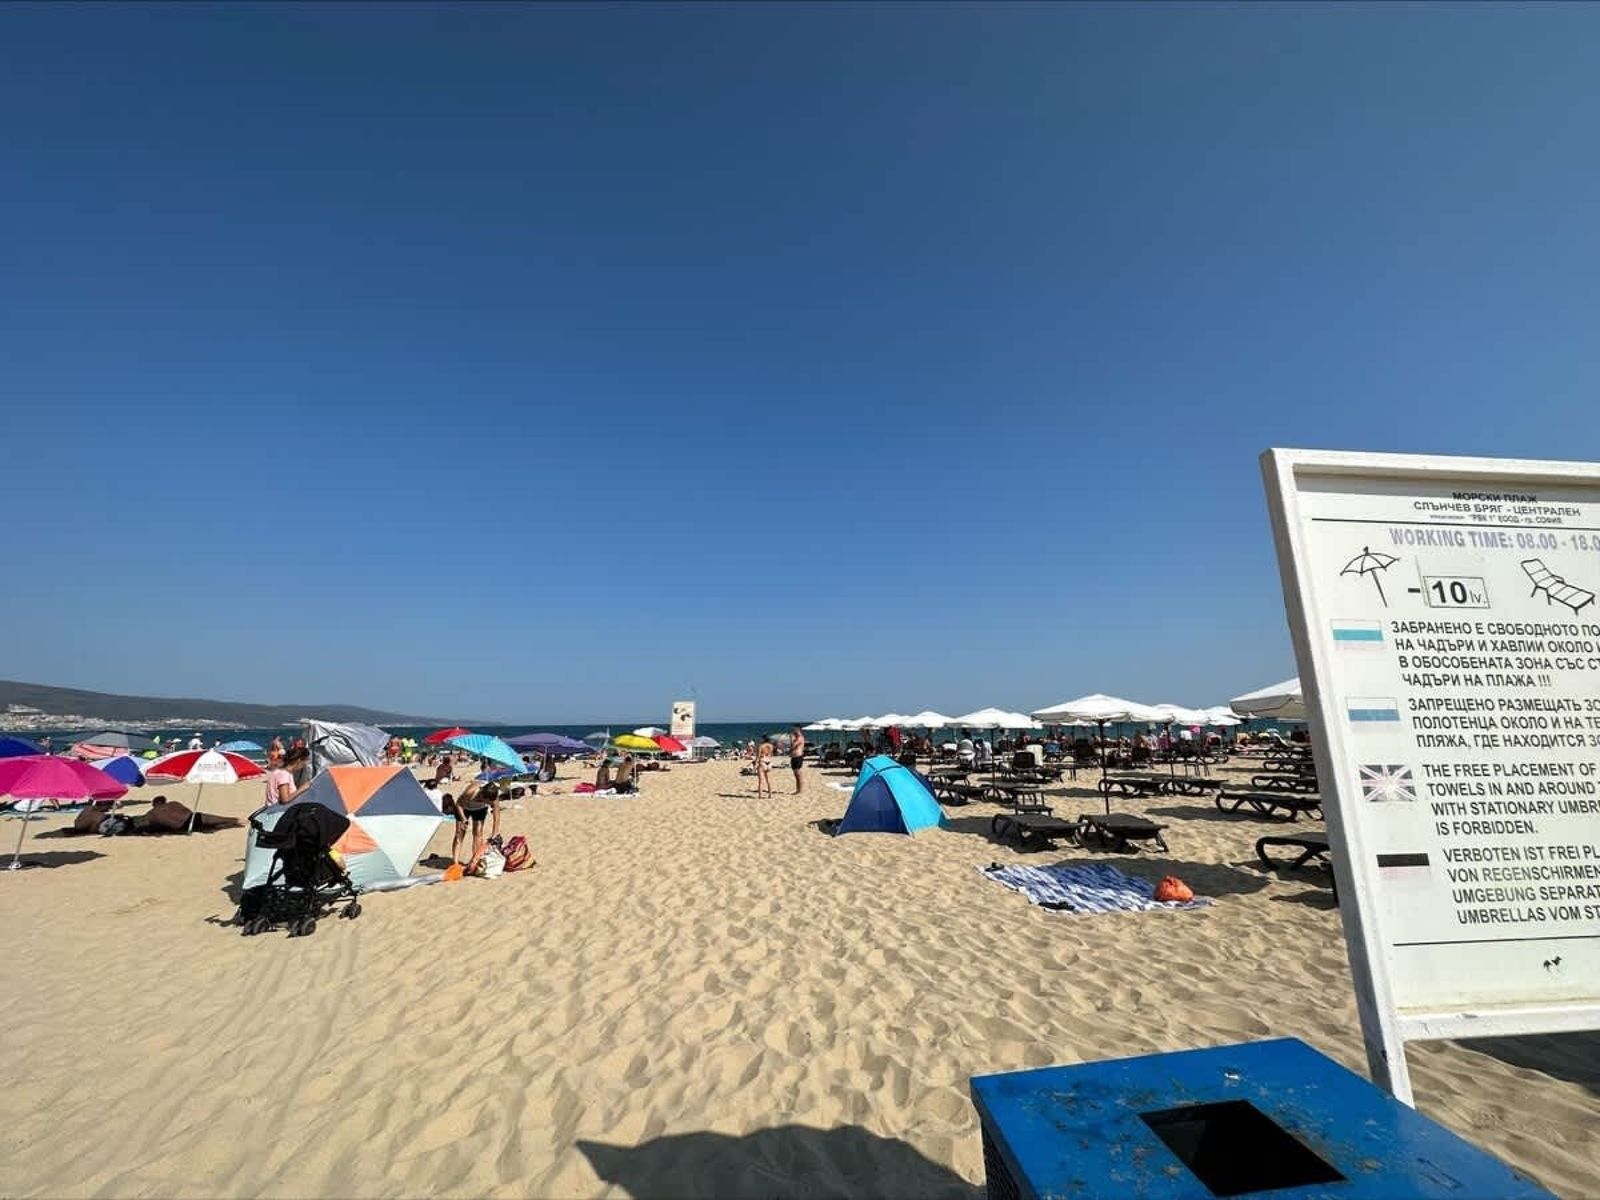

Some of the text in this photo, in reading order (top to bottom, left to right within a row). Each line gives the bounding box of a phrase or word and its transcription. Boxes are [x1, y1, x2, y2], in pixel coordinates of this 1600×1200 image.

[1452, 492, 1537, 503] МОРСКИ ПЛАЖ
[1413, 501, 1471, 512] СЛЪНЧЕВ
[1473, 503, 1503, 513] БРЯГ
[1513, 506, 1581, 517] ЦЕНТРАЛЕН
[1389, 527, 1466, 547] WORKING
[1468, 531, 1514, 549] TIME:
[1516, 532, 1558, 550] 08.00
[1432, 580, 1468, 604] 10
[1391, 621, 1473, 635] ЗАБРАНЕНО
[1475, 622, 1485, 635] Е
[1487, 622, 1579, 638] СВОБОДНОТО
[1395, 638, 1415, 651] НА
[1417, 639, 1475, 653] ЧАДЪРИ
[1477, 639, 1488, 652] И
[1490, 640, 1545, 652] ХАВЛИИ
[1547, 640, 1594, 653] ОКОЛО
[1399, 655, 1409, 668] В
[1411, 656, 1514, 669] ОБОСОБЕНАТА
[1515, 657, 1554, 670] ЗОНА
[1555, 657, 1585, 670] СЪС
[1402, 673, 1461, 688] ЧАДЪРИ
[1463, 674, 1484, 687] НА
[1485, 674, 1537, 687] ПЛАЖА
[1408, 698, 1496, 713] ЗАПРЕЩЕНО
[1498, 699, 1582, 713] РАЗМЕЩАТЬ
[1412, 716, 1499, 731] ПОЛОТЕНЦА
[1500, 716, 1548, 729] ОКОЛО
[1550, 716, 1561, 729] И
[1563, 716, 1584, 729] НА
[1416, 734, 1472, 749] ПЛЯЖА,
[1473, 734, 1501, 749] ГДЕ
[1502, 734, 1586, 749] НАХОДИТСЯ
[1422, 762, 1597, 777] THE FREE PLACEMENT OF
[1426, 782, 1486, 796] TOWELS
[1488, 782, 1503, 796] IN
[1506, 782, 1535, 796] AND
[1538, 781, 1596, 795] AROUND
[1431, 799, 1600, 816] WITH STATIONARY UMBR
[1435, 820, 1539, 836] IS FORBIDDEN.
[1442, 844, 1600, 862] VERBOTEN IST FREI PL
[1446, 867, 1479, 883] VON
[1451, 886, 1537, 904] UMGEBUNG
[1456, 907, 1547, 925] UMBRELLAS
[1547, 905, 1582, 921] VOM
